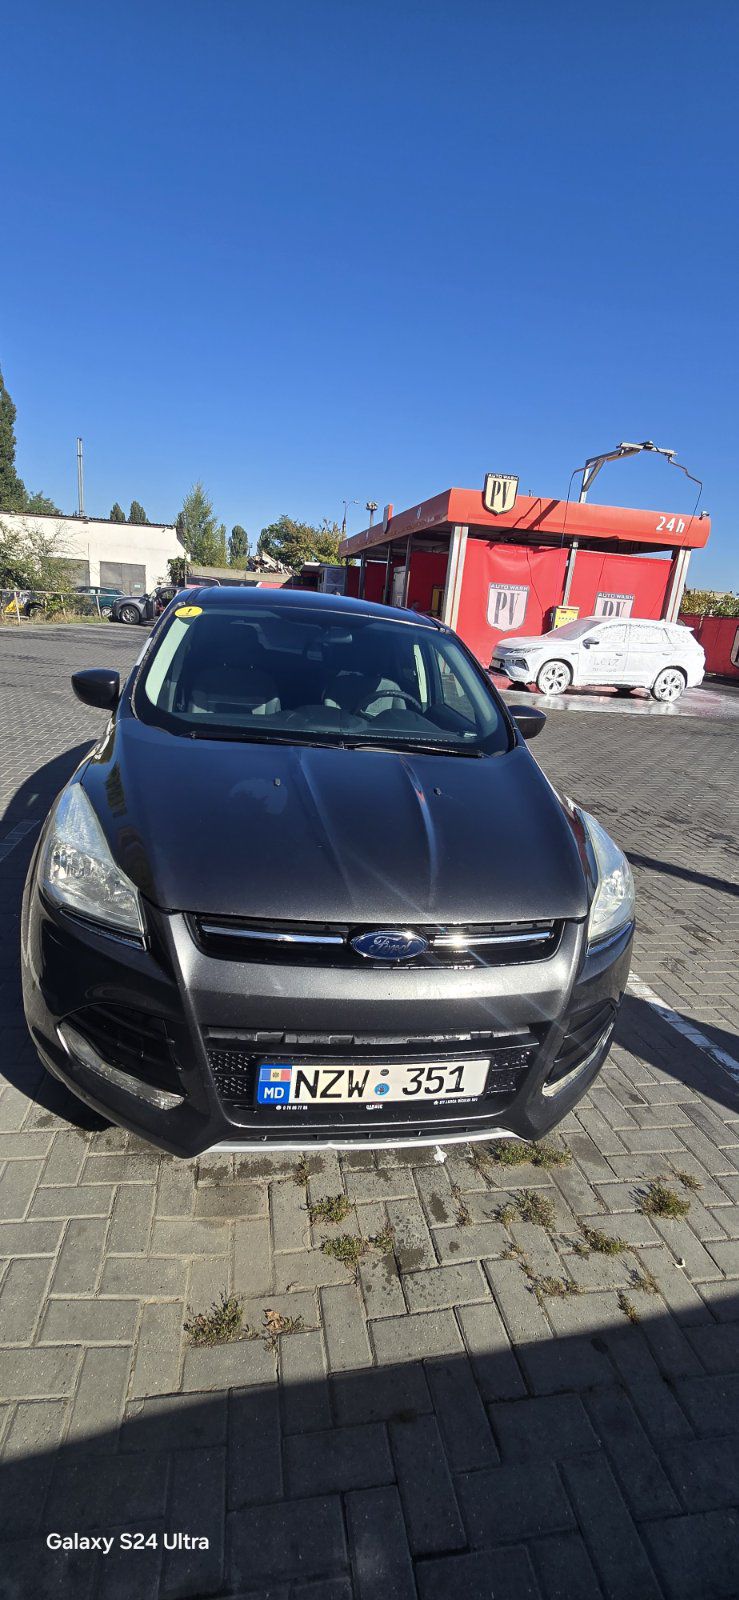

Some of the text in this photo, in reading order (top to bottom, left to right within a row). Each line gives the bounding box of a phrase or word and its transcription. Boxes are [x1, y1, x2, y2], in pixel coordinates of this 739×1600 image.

[490, 480, 511, 508] PV
[655, 516, 686, 533] 24h
[493, 591, 520, 626] PV
[369, 935, 413, 954] Ford
[263, 1086, 285, 1099] MD
[294, 1065, 465, 1099] NZW 351
